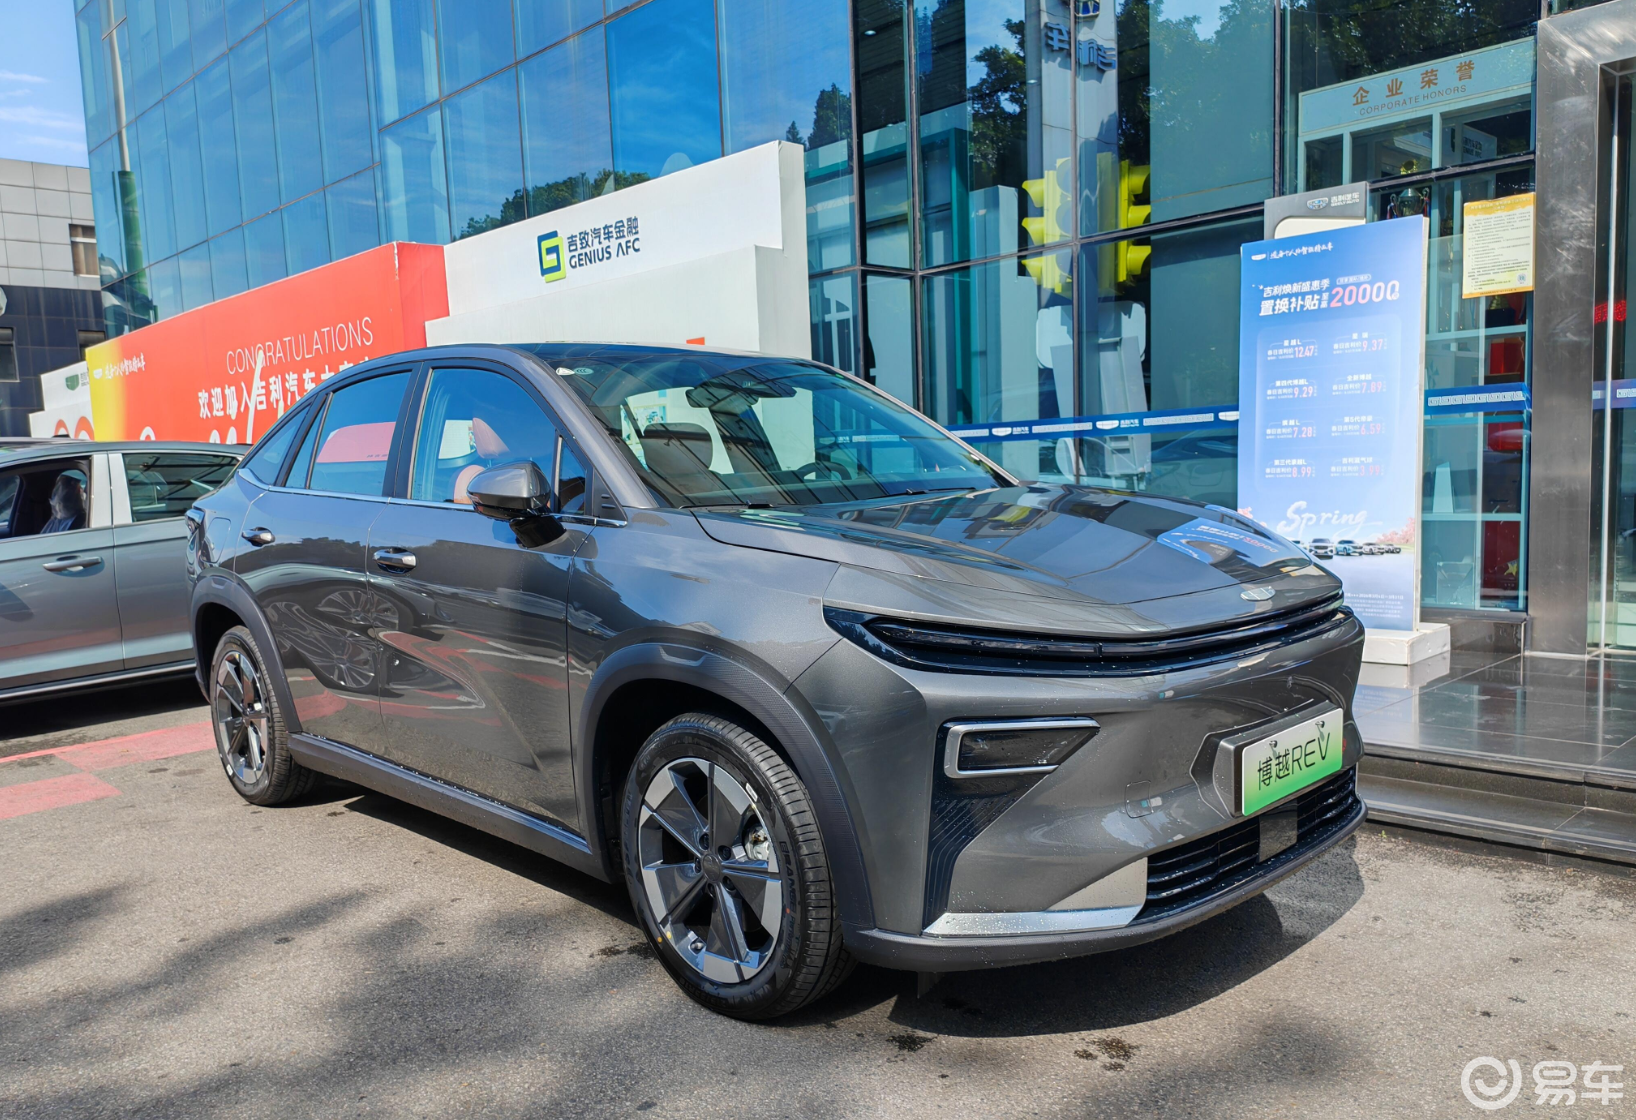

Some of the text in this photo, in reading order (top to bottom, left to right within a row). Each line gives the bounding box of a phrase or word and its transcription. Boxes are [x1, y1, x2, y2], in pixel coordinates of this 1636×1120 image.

[1352, 60, 1475, 106] 企业荣誉
[1360, 85, 1467, 116] CORPORATE HONORS
[567, 216, 640, 253] 吉致汽车金融
[569, 244, 612, 269] GENIUS
[1259, 293, 1321, 316] 置换补贴
[1330, 280, 1400, 308] 20000
[226, 316, 374, 375] CONGRATULATIONS
[1362, 339, 1384, 352] 9.37
[1293, 386, 1314, 398] 9.29
[1293, 426, 1313, 438] 7.28
[1292, 466, 1312, 478] 8.99
[1276, 500, 1383, 540] Spring
[1257, 732, 1331, 791] 博越REV
